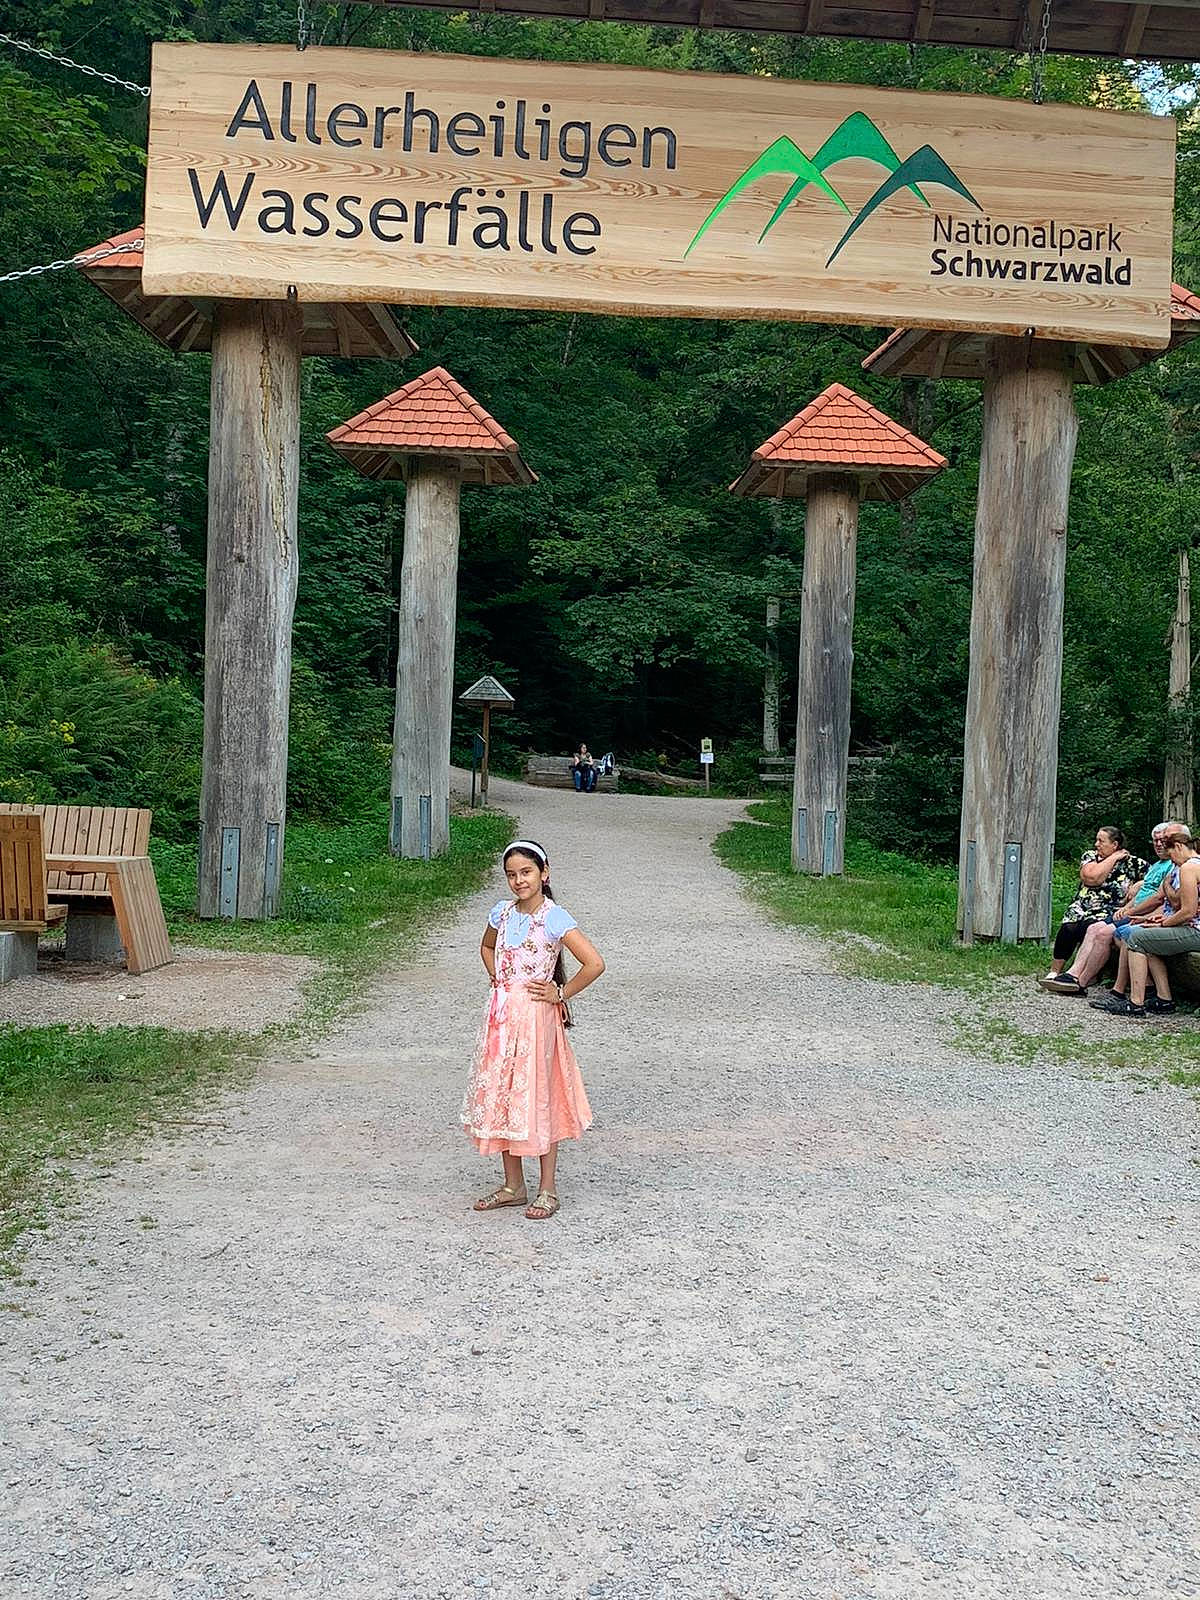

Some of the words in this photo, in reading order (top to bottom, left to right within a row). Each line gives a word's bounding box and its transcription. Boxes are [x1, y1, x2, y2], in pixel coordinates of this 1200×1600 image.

[226, 79, 677, 179] Allerheiligen
[186, 167, 602, 256] Wasserfälle
[932, 213, 1122, 257] Nationalpark
[930, 248, 1132, 286] Schwarzwald
